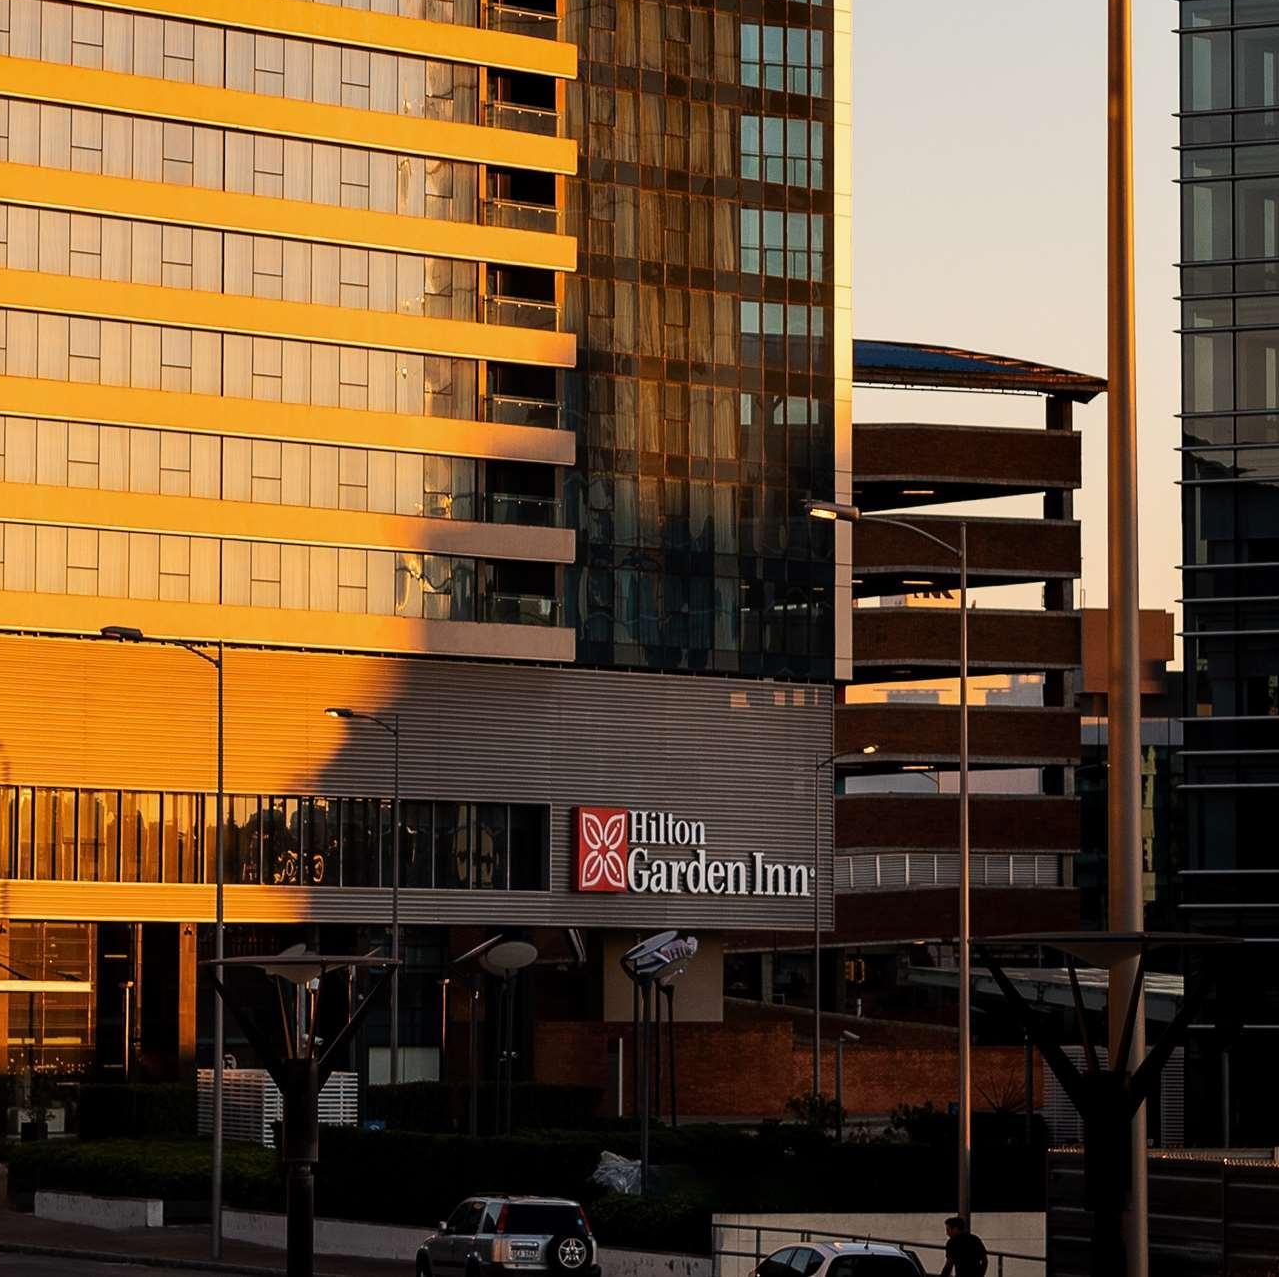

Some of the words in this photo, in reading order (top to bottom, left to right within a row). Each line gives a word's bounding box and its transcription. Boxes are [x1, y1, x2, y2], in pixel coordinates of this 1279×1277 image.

[628, 810, 707, 845] Hilton
[627, 847, 749, 895] Garden
[752, 851, 811, 897] Inn
